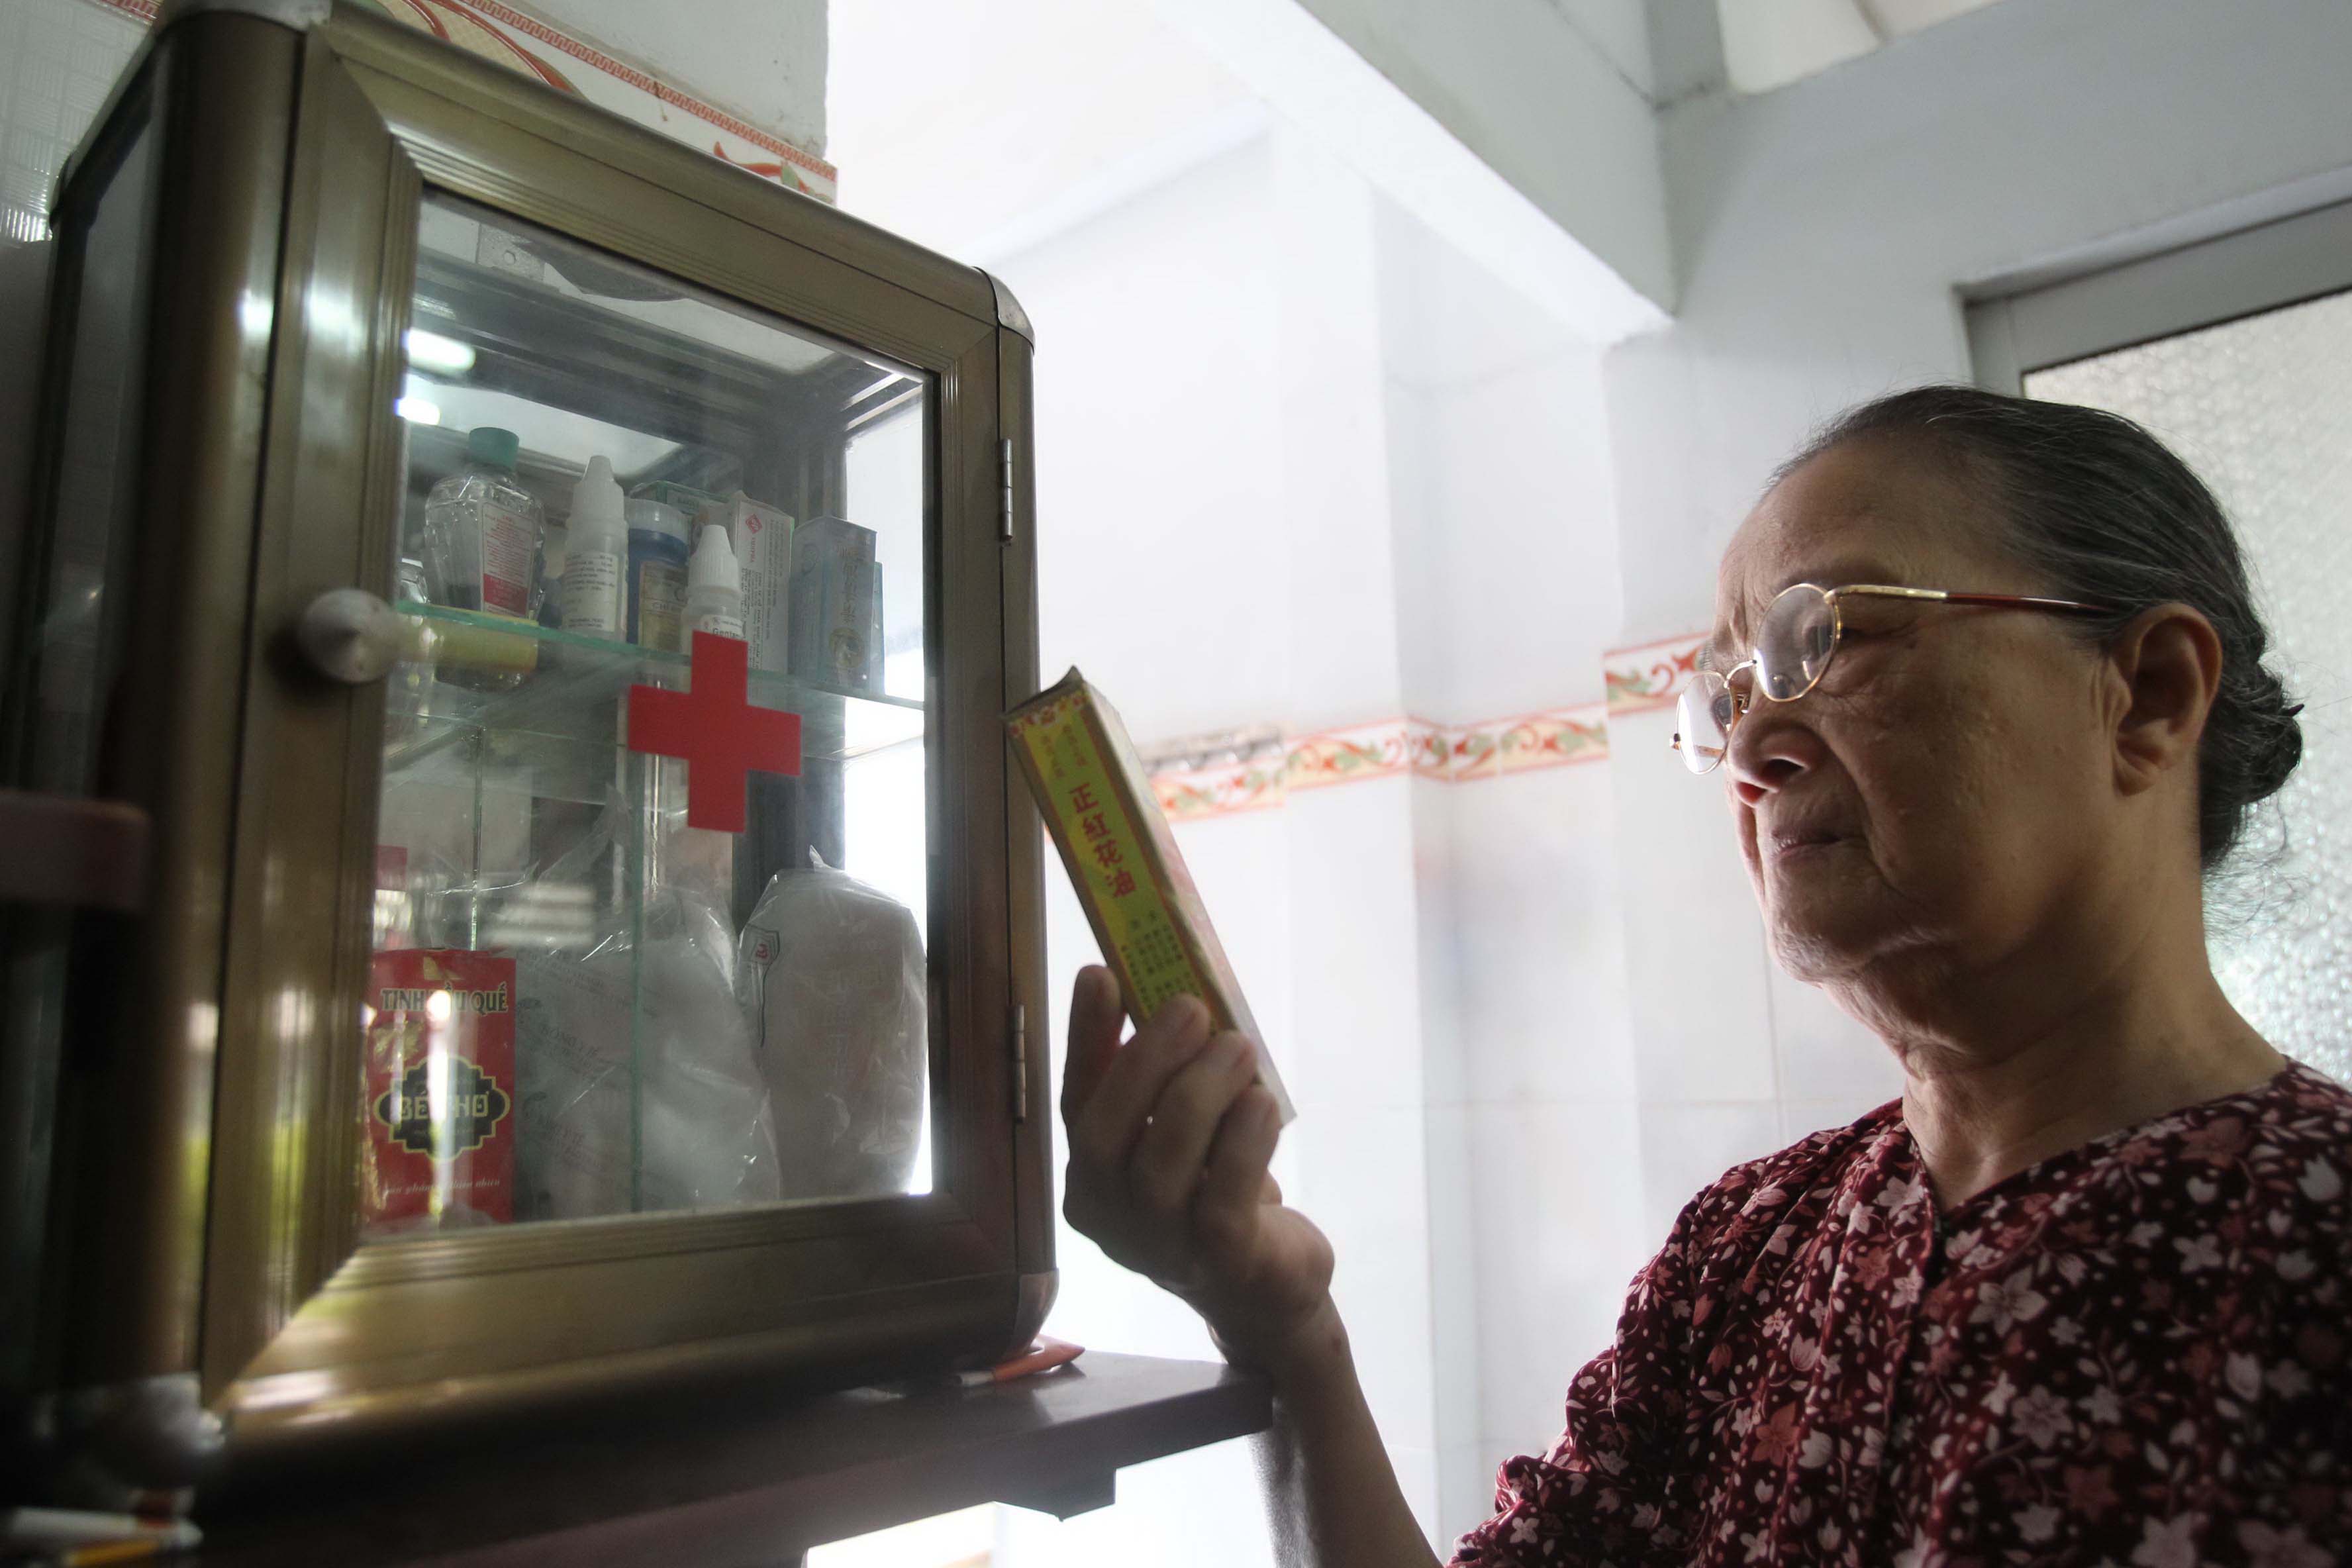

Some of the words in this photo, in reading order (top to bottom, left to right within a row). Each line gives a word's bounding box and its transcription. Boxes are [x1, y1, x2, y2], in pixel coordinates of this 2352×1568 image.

[1069, 782, 1137, 899] 正紅花油
[380, 988, 426, 1012] TINH
[471, 981, 509, 1016] QUẾ
